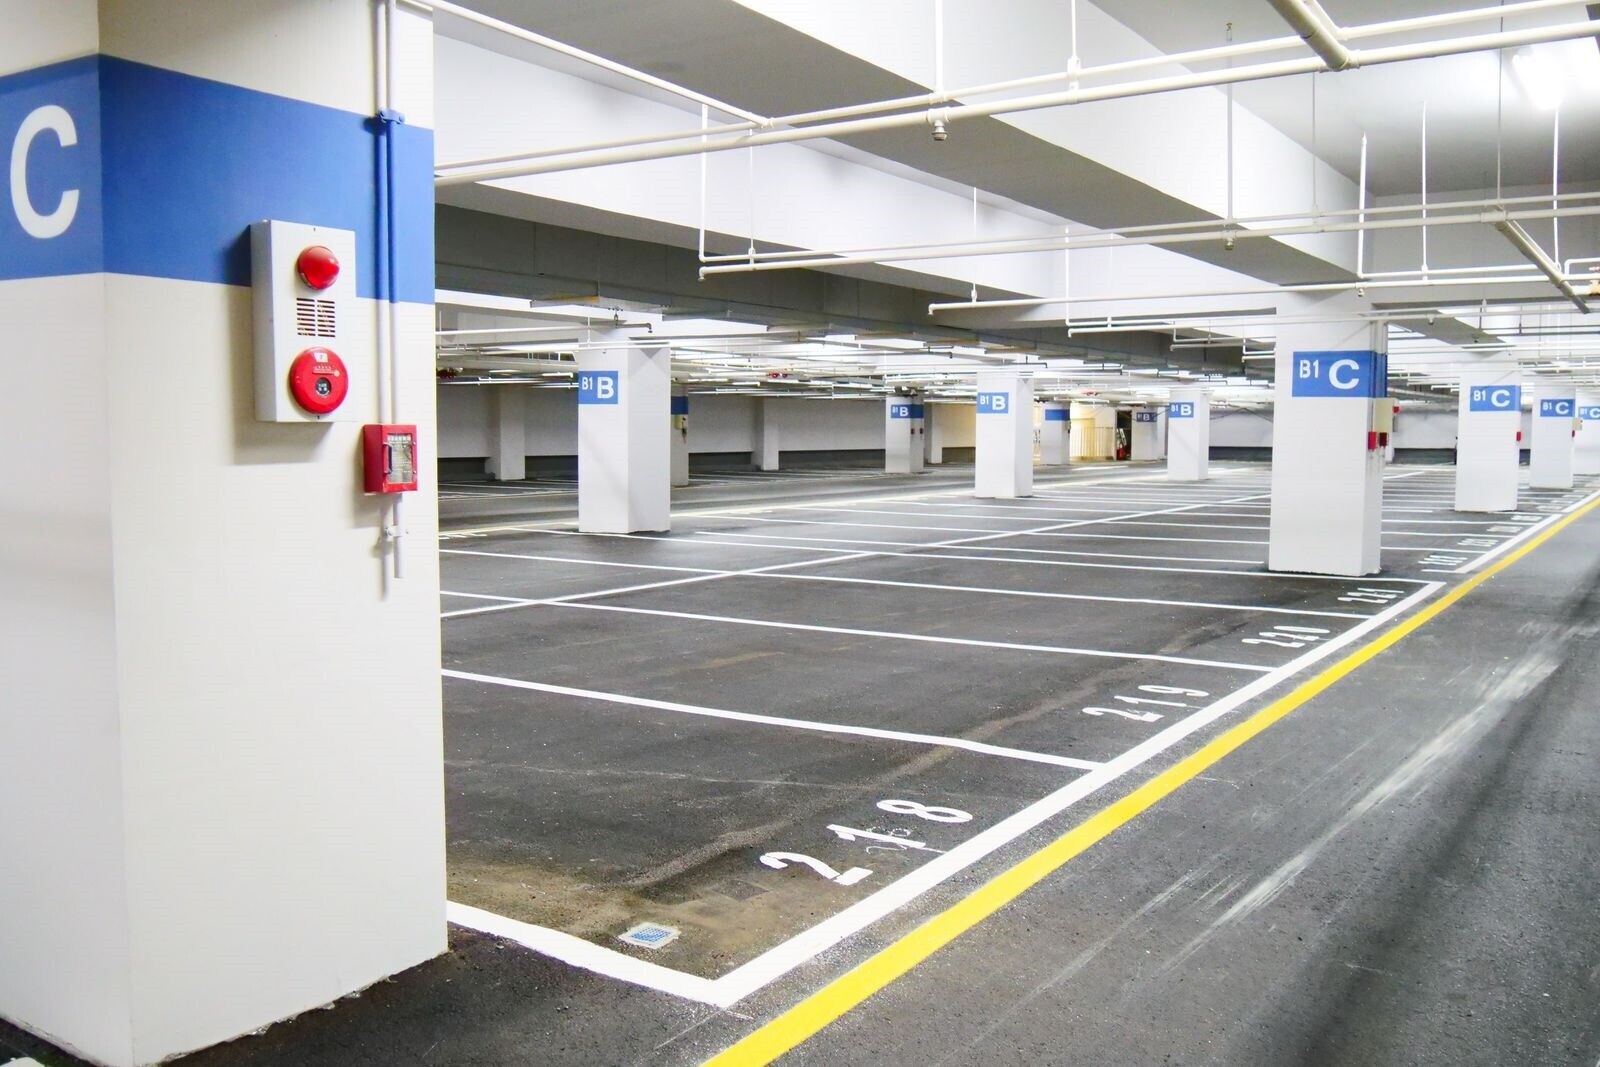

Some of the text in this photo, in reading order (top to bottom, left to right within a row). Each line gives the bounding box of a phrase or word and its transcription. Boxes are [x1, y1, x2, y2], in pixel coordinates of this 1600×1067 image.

[10, 105, 79, 238] C
[1299, 359, 1360, 389] B1 C
[581, 376, 614, 399] B1 B
[980, 396, 1006, 411] B1 B
[1473, 389, 1510, 408] B1 C
[1555, 401, 1569, 415] C
[900, 406, 909, 417] B
[1180, 404, 1192, 416] B
[1590, 407, 1600, 418] C
[1242, 625, 1331, 648] 220
[1082, 684, 1209, 723] 219
[759, 799, 973, 886] 218
